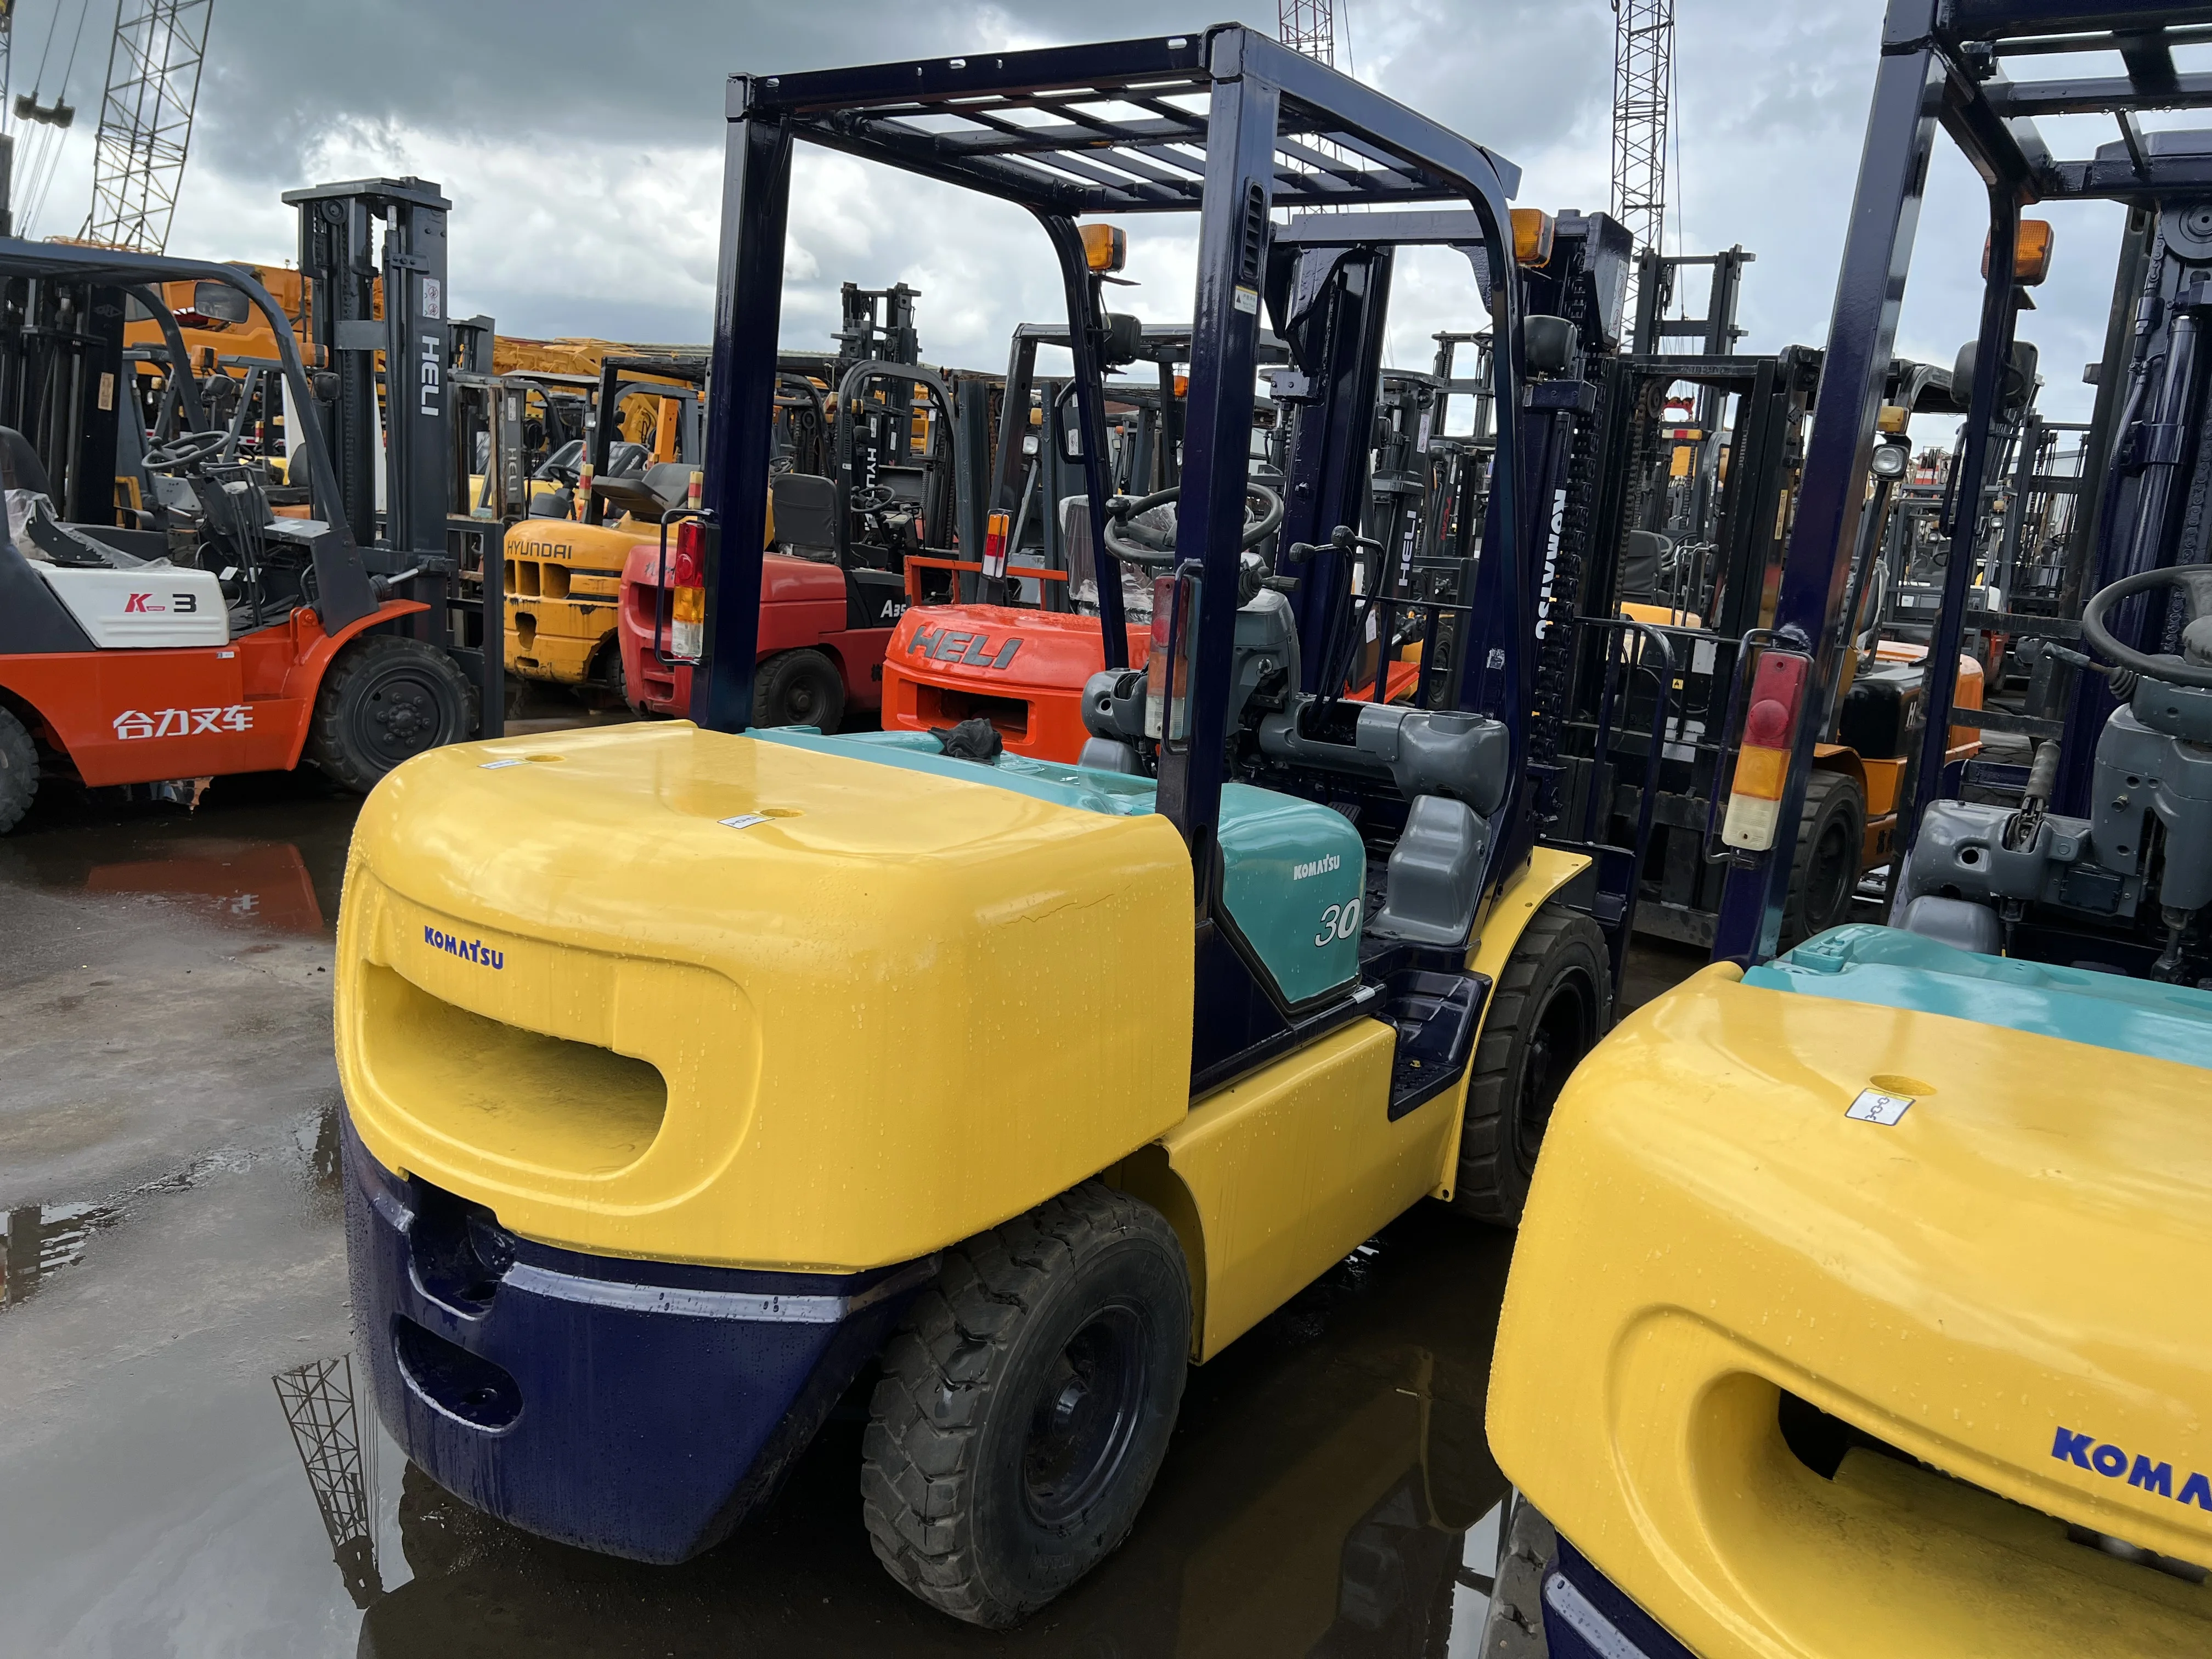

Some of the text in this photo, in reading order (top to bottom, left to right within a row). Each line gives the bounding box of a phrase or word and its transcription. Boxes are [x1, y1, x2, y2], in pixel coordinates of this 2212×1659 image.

[421, 336, 440, 416] HELI
[507, 448, 518, 493] HELI
[507, 540, 572, 560] HYUNDAI
[1398, 510, 1417, 586] HELI
[172, 593, 196, 612] 3
[907, 624, 1025, 669] HELI
[113, 704, 253, 740] 合力叉车
[1294, 854, 1340, 881] KOMATSU
[1314, 898, 1361, 947] 30
[424, 925, 504, 969] KOMATSU
[2051, 1426, 2212, 1512] KOMA
